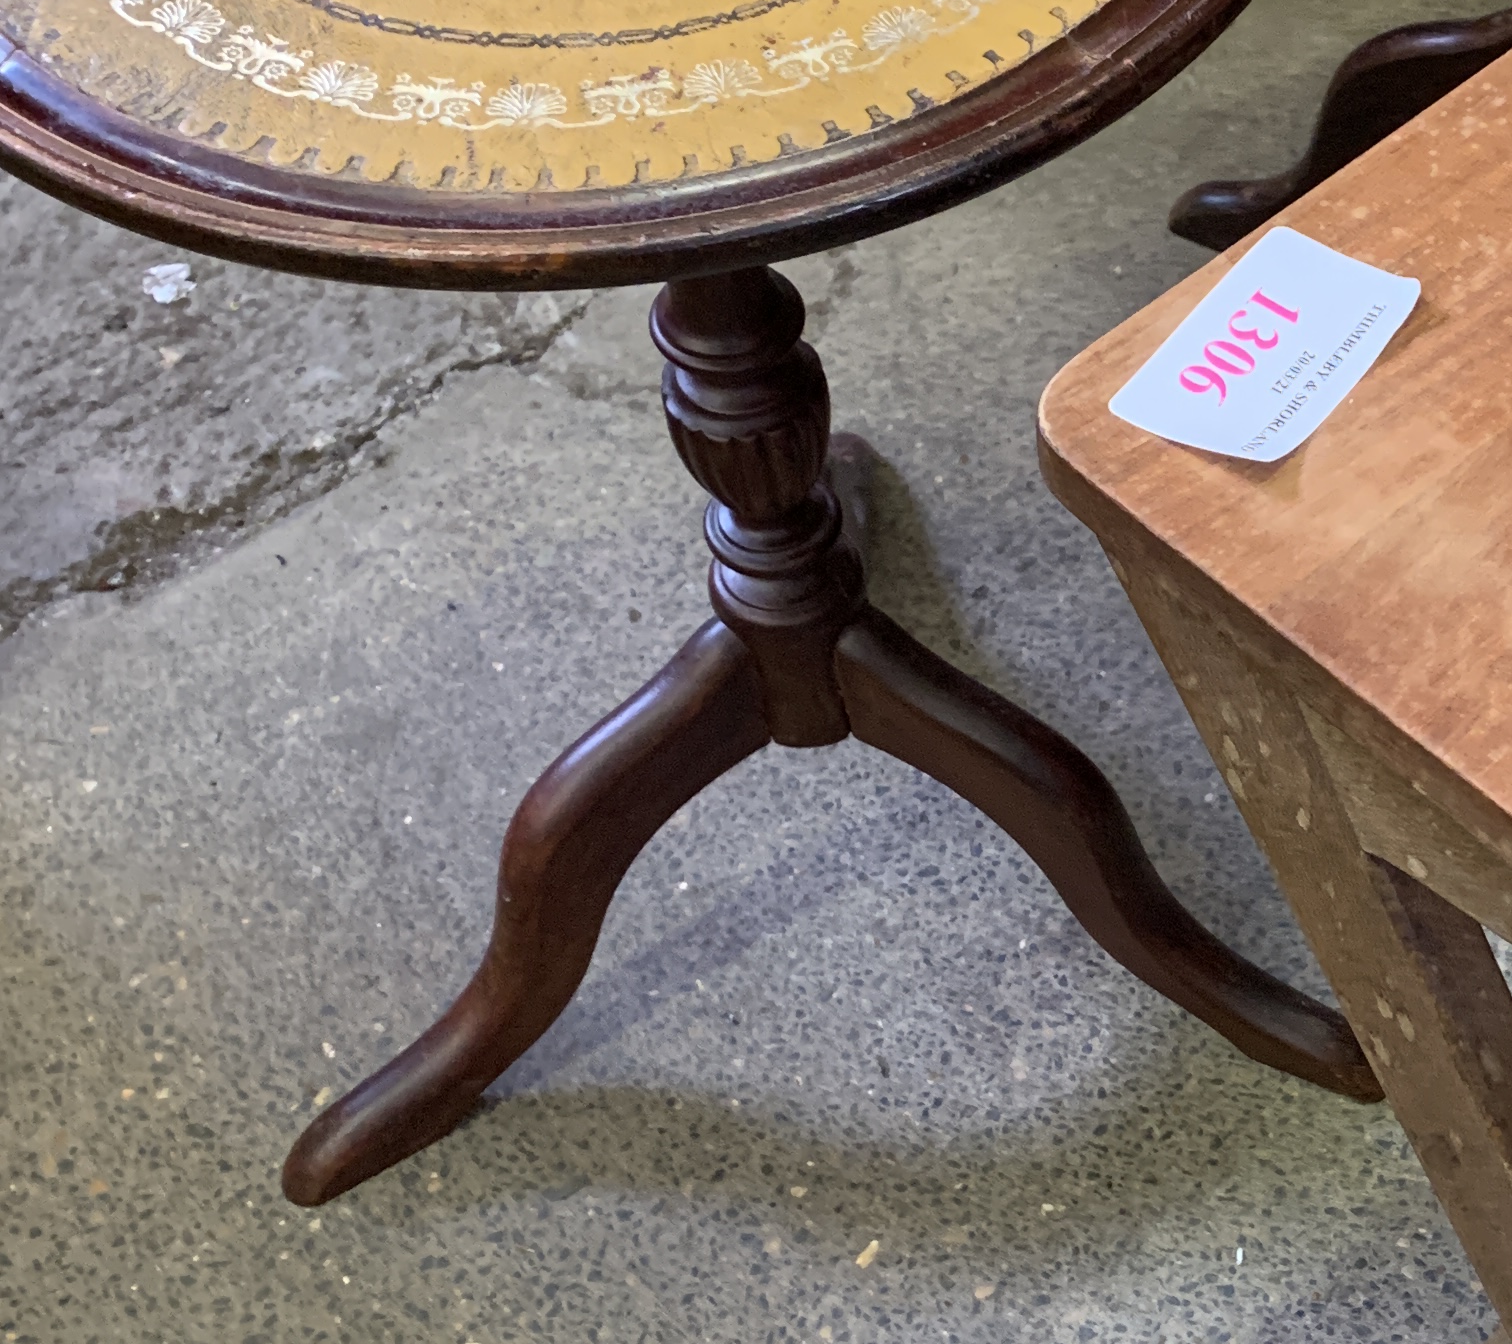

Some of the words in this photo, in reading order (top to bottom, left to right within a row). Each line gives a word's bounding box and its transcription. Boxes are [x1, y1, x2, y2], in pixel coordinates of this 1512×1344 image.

[1179, 287, 1300, 407] 1306
[1270, 350, 1317, 395] 20/03/21
[1316, 304, 1387, 382] THIMBLEBY
[1303, 380, 1318, 392] &
